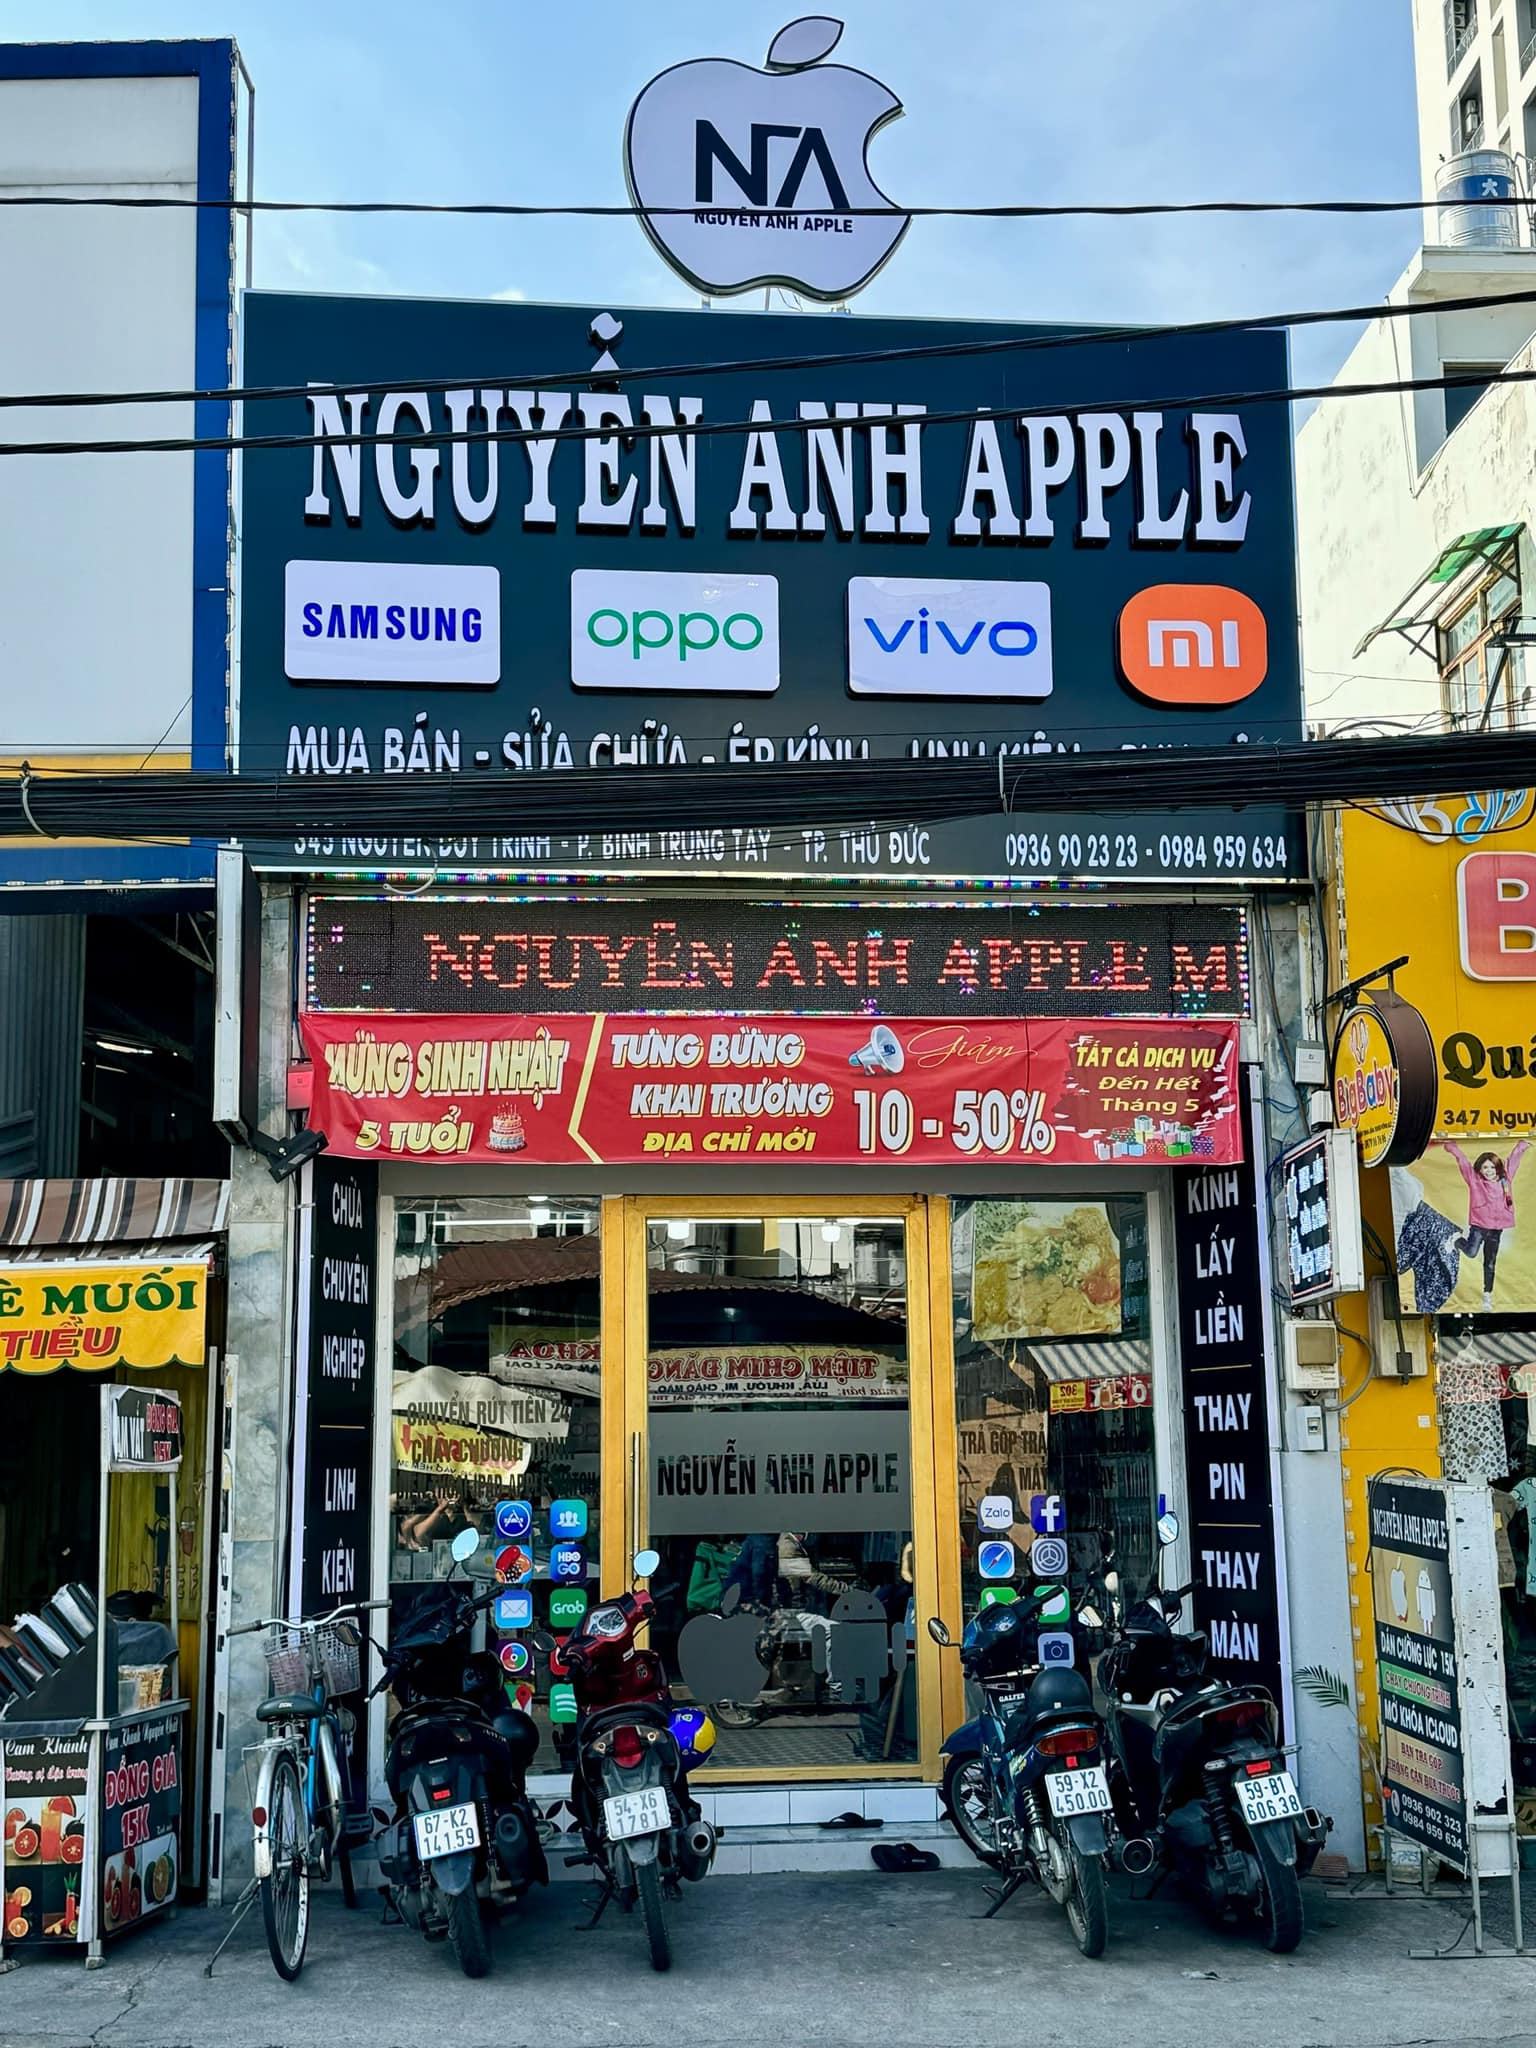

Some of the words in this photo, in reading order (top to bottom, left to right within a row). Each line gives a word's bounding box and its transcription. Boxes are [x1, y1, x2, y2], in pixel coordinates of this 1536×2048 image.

[766, 212, 799, 230] ANH
[803, 216, 853, 233] APPLE
[729, 398, 930, 535] ANH
[953, 407, 1252, 543] APPLE
[302, 602, 482, 642] SAMSUNG
[287, 725, 370, 774] MUA
[384, 711, 460, 773] BÁN
[802, 830, 828, 864] TP.
[889, 824, 931, 865] ĐỨC
[1005, 833, 1051, 867] 0936
[1058, 833, 1082, 868] 90
[1087, 834, 1110, 868] 23
[1115, 834, 1138, 868] 23
[1159, 834, 1207, 868] 0984
[1213, 835, 1246, 868] 959
[1252, 836, 1287, 868] 634
[757, 938, 913, 987] ANH
[937, 938, 1152, 992] APPLE
[611, 1027, 704, 1068] TƯNG
[708, 1025, 806, 1068] BỪNG
[907, 1025, 1038, 1068] Giảm
[1076, 1040, 1113, 1068] TẤT
[1115, 1041, 1139, 1068] CẢ
[1143, 1047, 1186, 1072] DỊCH
[1191, 1048, 1217, 1072] VỤ
[415, 1040, 488, 1097] SINH
[488, 1025, 570, 1110] NHẬT
[1098, 1075, 1149, 1091] Đến
[1154, 1075, 1202, 1091] Hết
[629, 1083, 707, 1118] KHAI
[710, 1076, 834, 1118] TRƯƠNG
[1100, 1097, 1178, 1115] Tháng
[1183, 1098, 1200, 1112] 5
[354, 1119, 382, 1151] 5
[389, 1105, 475, 1153] TUỔI
[854, 1090, 912, 1154] 10
[951, 1089, 1056, 1156] 50%
[1443, 1109, 1481, 1126] 347
[643, 1131, 694, 1159] ĐỊA
[702, 1126, 754, 1153] CHỈ
[755, 1127, 817, 1153] MỚI
[1187, 1165, 1239, 1214] KÍNH
[1195, 1223, 1236, 1279] LẤY
[41, 1266, 199, 1317] MUỐI
[322, 1254, 368, 1305] CHUYÊN
[1195, 1290, 1244, 1345] LIỀN
[322, 1332, 366, 1391] NGHIỆP
[477, 1395, 510, 1425] RÚT
[1194, 1392, 1252, 1432] THAY
[657, 1438, 757, 1497] NGUYỄN
[765, 1452, 815, 1495] ANH
[822, 1452, 900, 1495] APPLE
[1208, 1462, 1246, 1500] PIN
[325, 1468, 356, 1512] LINH
[984, 1507, 1010, 1518] Zalo
[1404, 1513, 1421, 1545] ANH
[1422, 1517, 1447, 1550] APPLE
[322, 1537, 355, 1606] KIỆN
[557, 1551, 581, 1563] HBO
[557, 1563, 581, 1575] GO
[1201, 1550, 1260, 1590] THAY
[552, 1600, 585, 1614] Grab
[1211, 1610, 1259, 1662] MÀN
[1441, 1650, 1456, 1677] 15K
[1384, 1695, 1398, 1724] MỞ
[1400, 1704, 1425, 1736] KHÓA
[1425, 1715, 1458, 1749] ICLOUD
[5, 1739, 35, 1757] Cam
[40, 1735, 88, 1755] Khánh
[105, 1754, 150, 1810] ĐỒNG
[152, 1744, 177, 1794] GIÁ
[1054, 1770, 1100, 1794] 59-X2
[1244, 1775, 1288, 1801] 59-B1
[424, 1807, 470, 1835] 67-K2
[613, 1791, 659, 1817] 54-X6
[1055, 1789, 1109, 1815] 450.00
[1246, 1794, 1300, 1823] 606.38
[1401, 1793, 1424, 1814] 0936
[1425, 1805, 1442, 1824] 902
[1444, 1815, 1462, 1834] 323
[121, 1803, 151, 1849] 15K
[423, 1826, 476, 1856] 141.59
[1402, 1810, 1425, 1831] 0984
[1426, 1822, 1443, 1841] 959
[1445, 1832, 1463, 1851] 634
